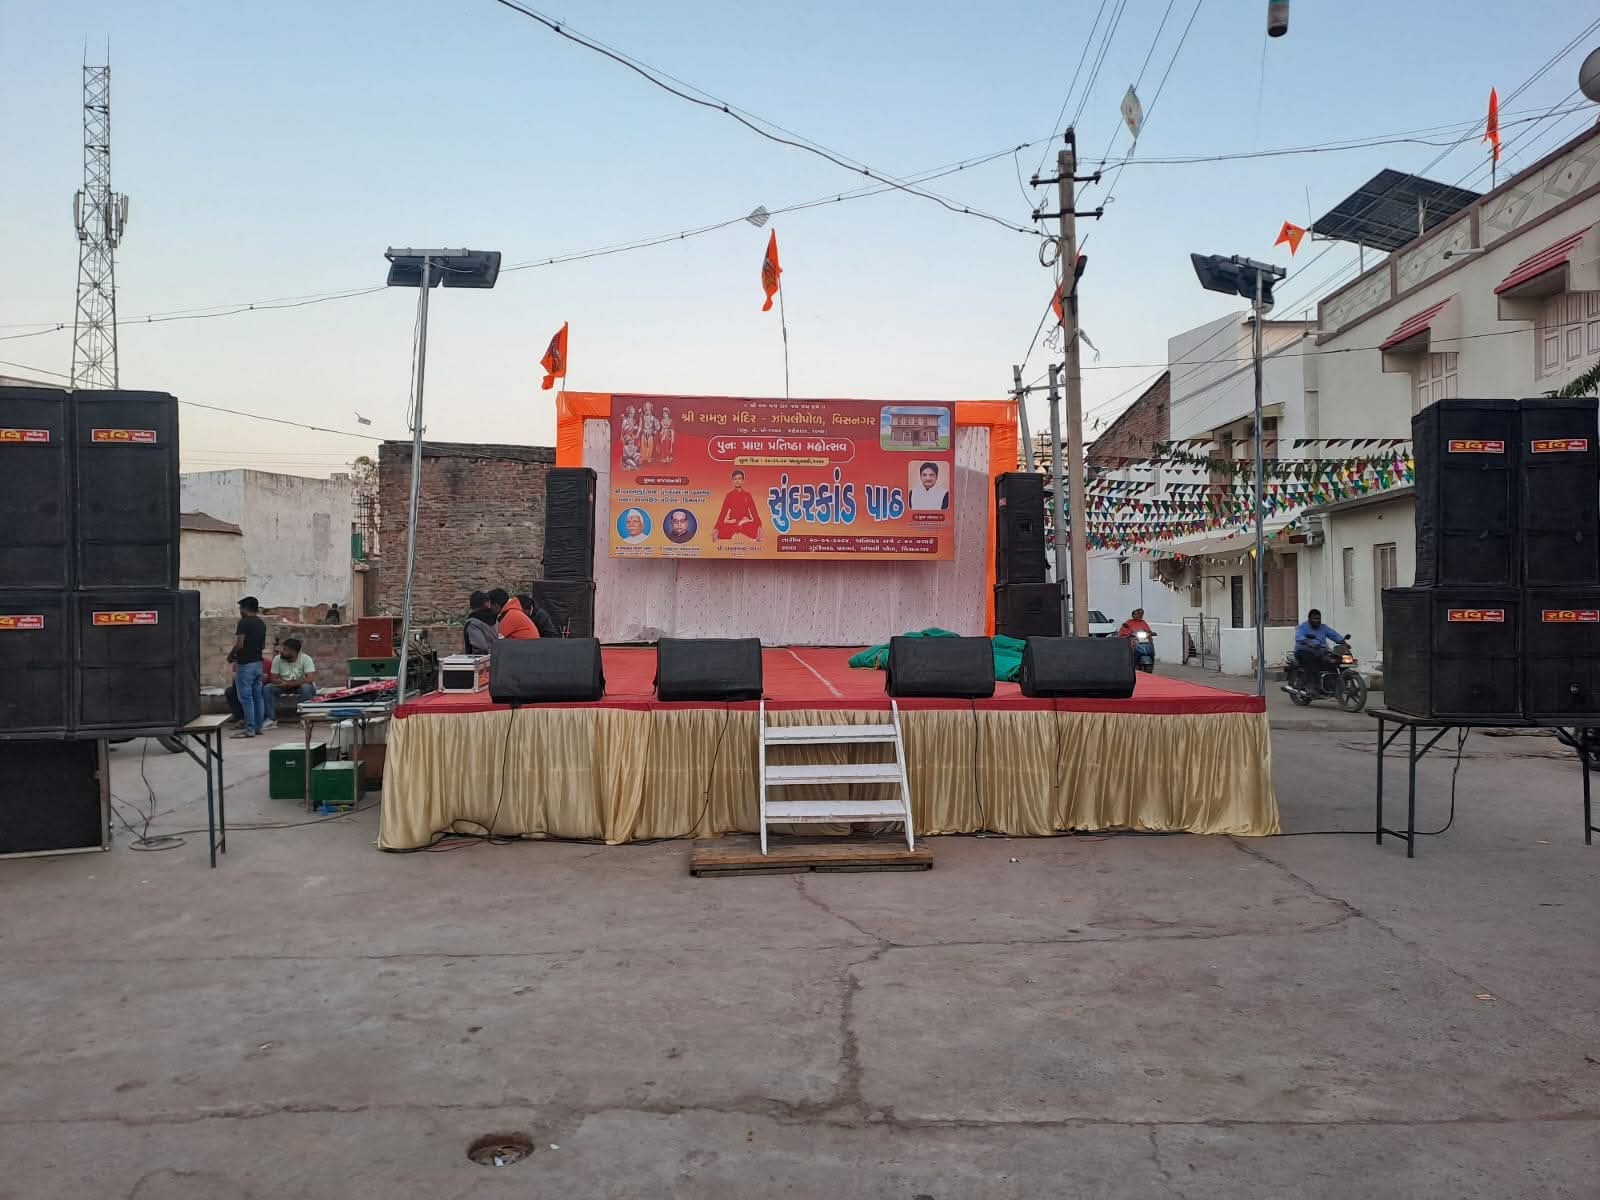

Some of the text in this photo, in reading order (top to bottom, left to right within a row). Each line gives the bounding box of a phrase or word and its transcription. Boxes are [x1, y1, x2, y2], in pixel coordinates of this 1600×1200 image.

[681, 410, 695, 423] શ્રી
[699, 412, 727, 425] રામજી
[731, 411, 757, 423] મંદિર
[832, 412, 877, 425] વિસનગર
[717, 438, 847, 454] પુનઃ પ્રાણ પ્રતિષ્ઠા મહોત્સવ
[768, 466, 906, 534] સુંદરકાંડ પાઠ
